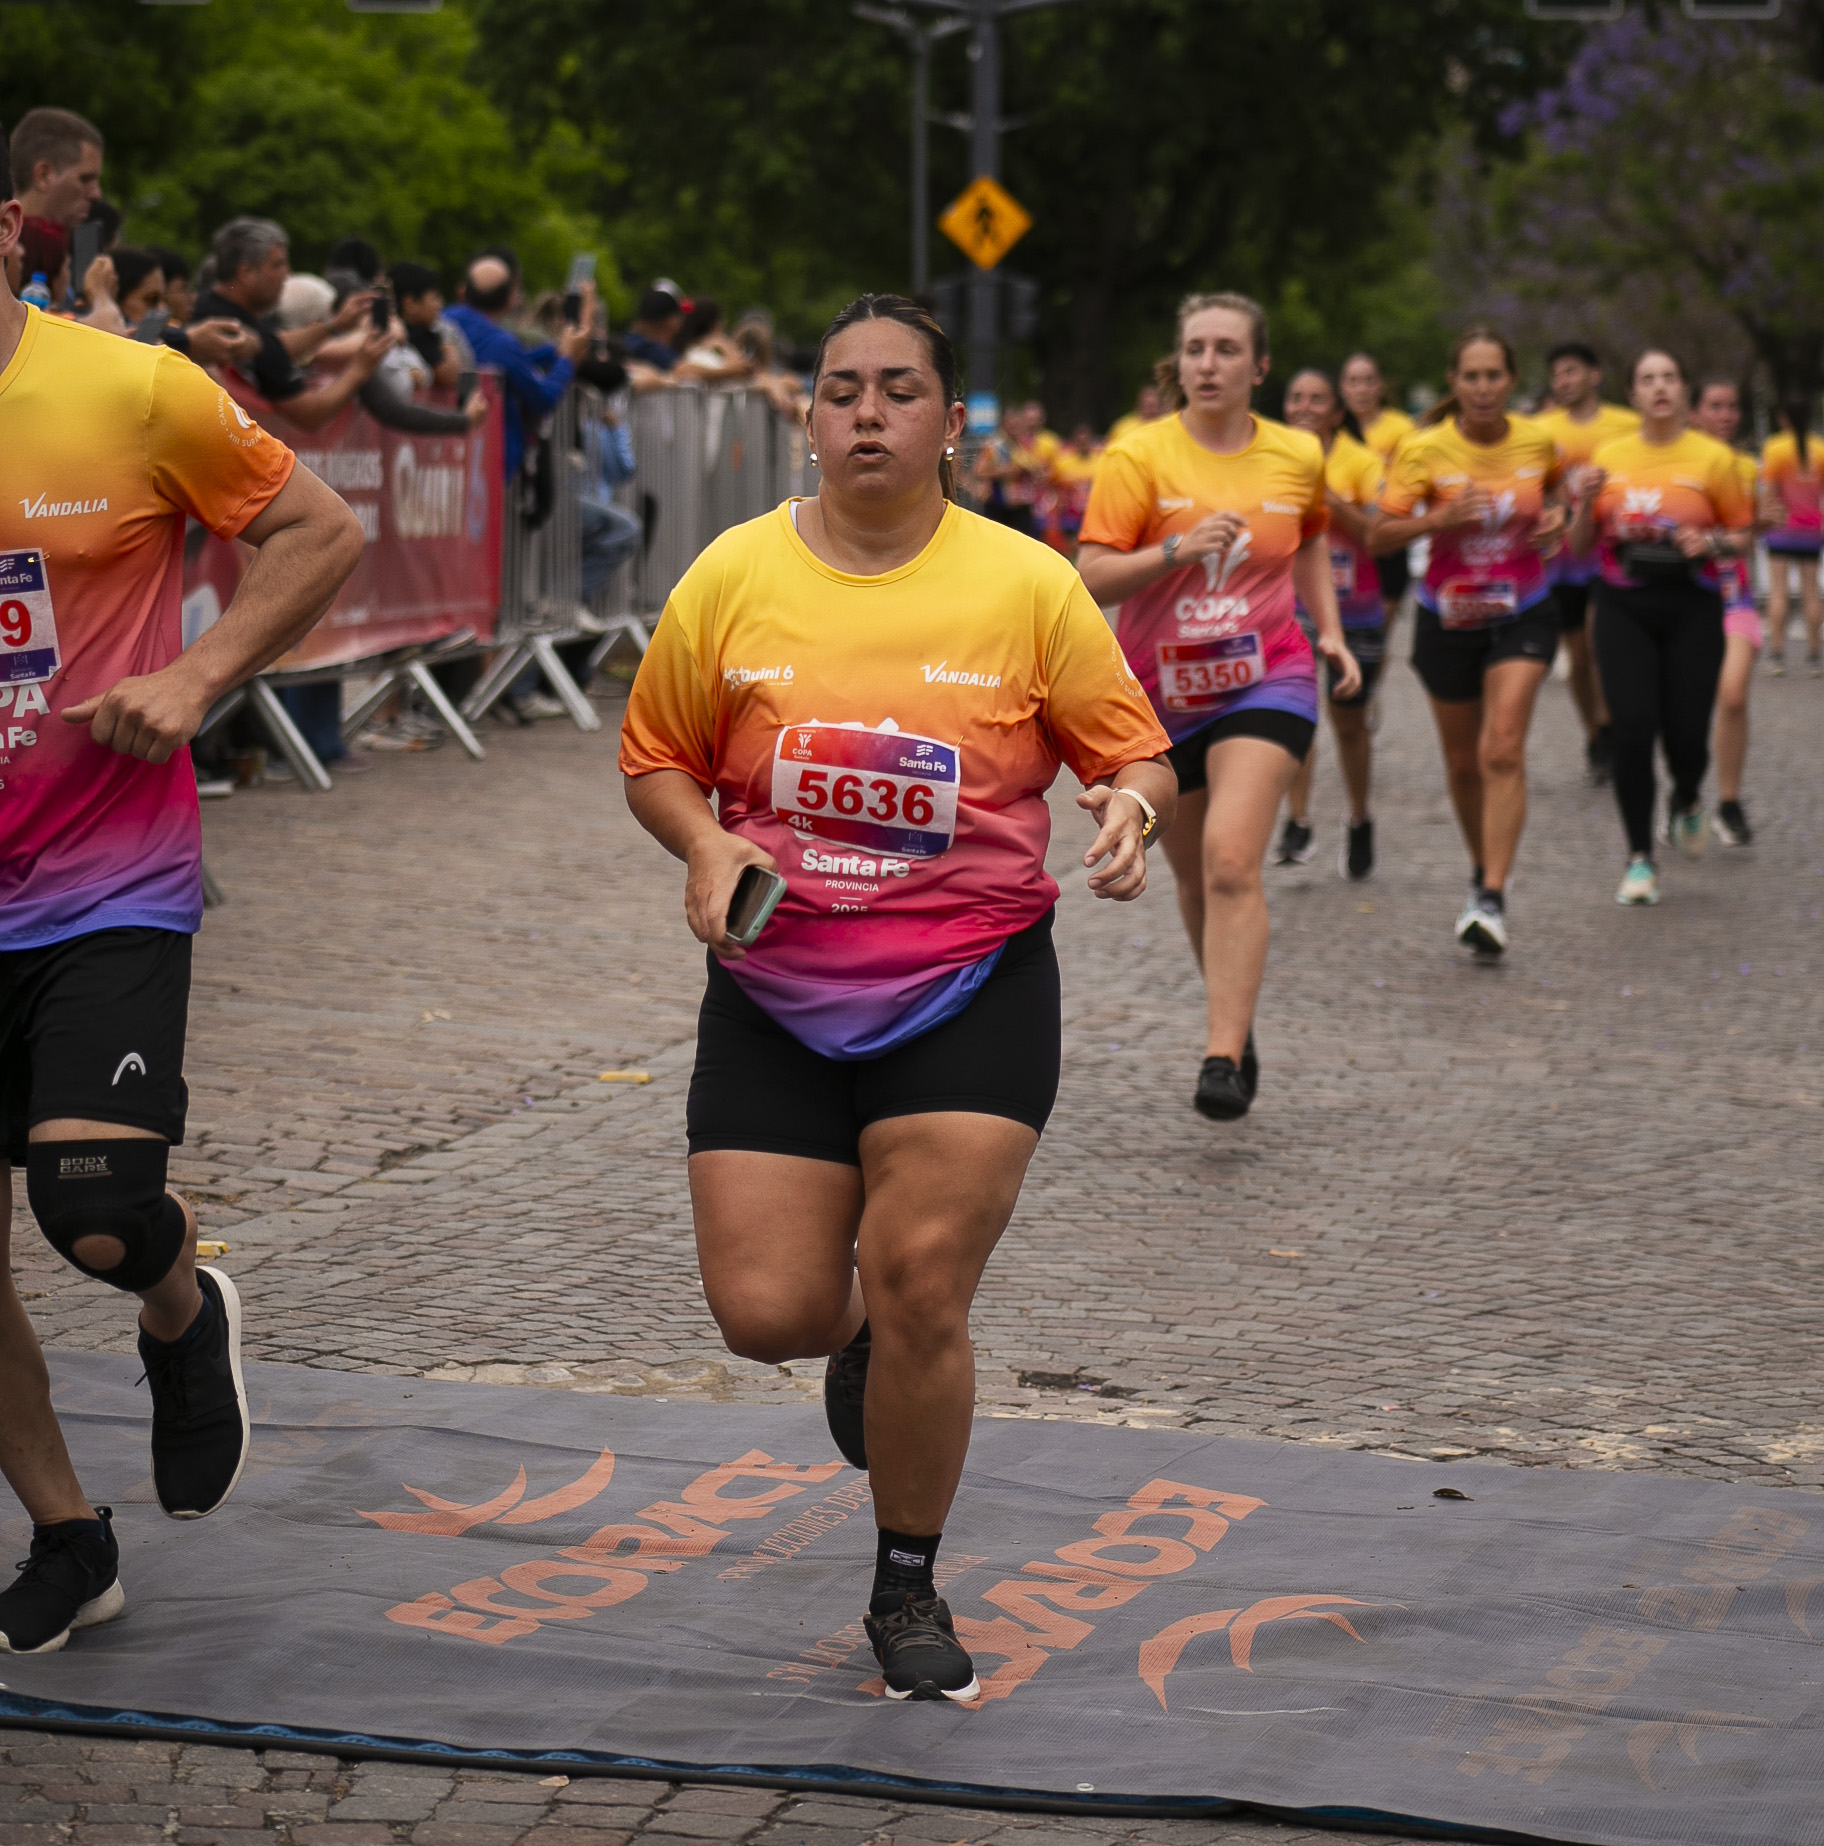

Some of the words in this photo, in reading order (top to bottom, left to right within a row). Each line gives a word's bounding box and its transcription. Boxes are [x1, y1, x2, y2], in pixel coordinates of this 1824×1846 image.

[19, 491, 108, 519] VANDALIA
[20, 572, 33, 583] Fe
[1175, 595, 1250, 622] COPA
[10, 672, 28, 680] Santa
[741, 665, 781, 683] Quini
[783, 664, 794, 680] 6
[920, 660, 1002, 688] VANDALIA
[1175, 659, 1252, 692] 5350
[7, 726, 38, 749] Fe
[792, 747, 813, 757] COPA
[899, 756, 933, 771] Santa
[934, 761, 947, 773] Fe
[796, 769, 935, 826] 5636
[787, 814, 814, 831] 4k
[801, 848, 877, 877] Santa
[880, 857, 910, 878] Fe
[825, 879, 880, 892] PROVINCIA
[60, 1156, 107, 1166] BODY
[60, 1163, 108, 1174] CARE
[384, 1449, 849, 1645] ECORACE
[857, 1478, 1268, 1710] ECORAC
